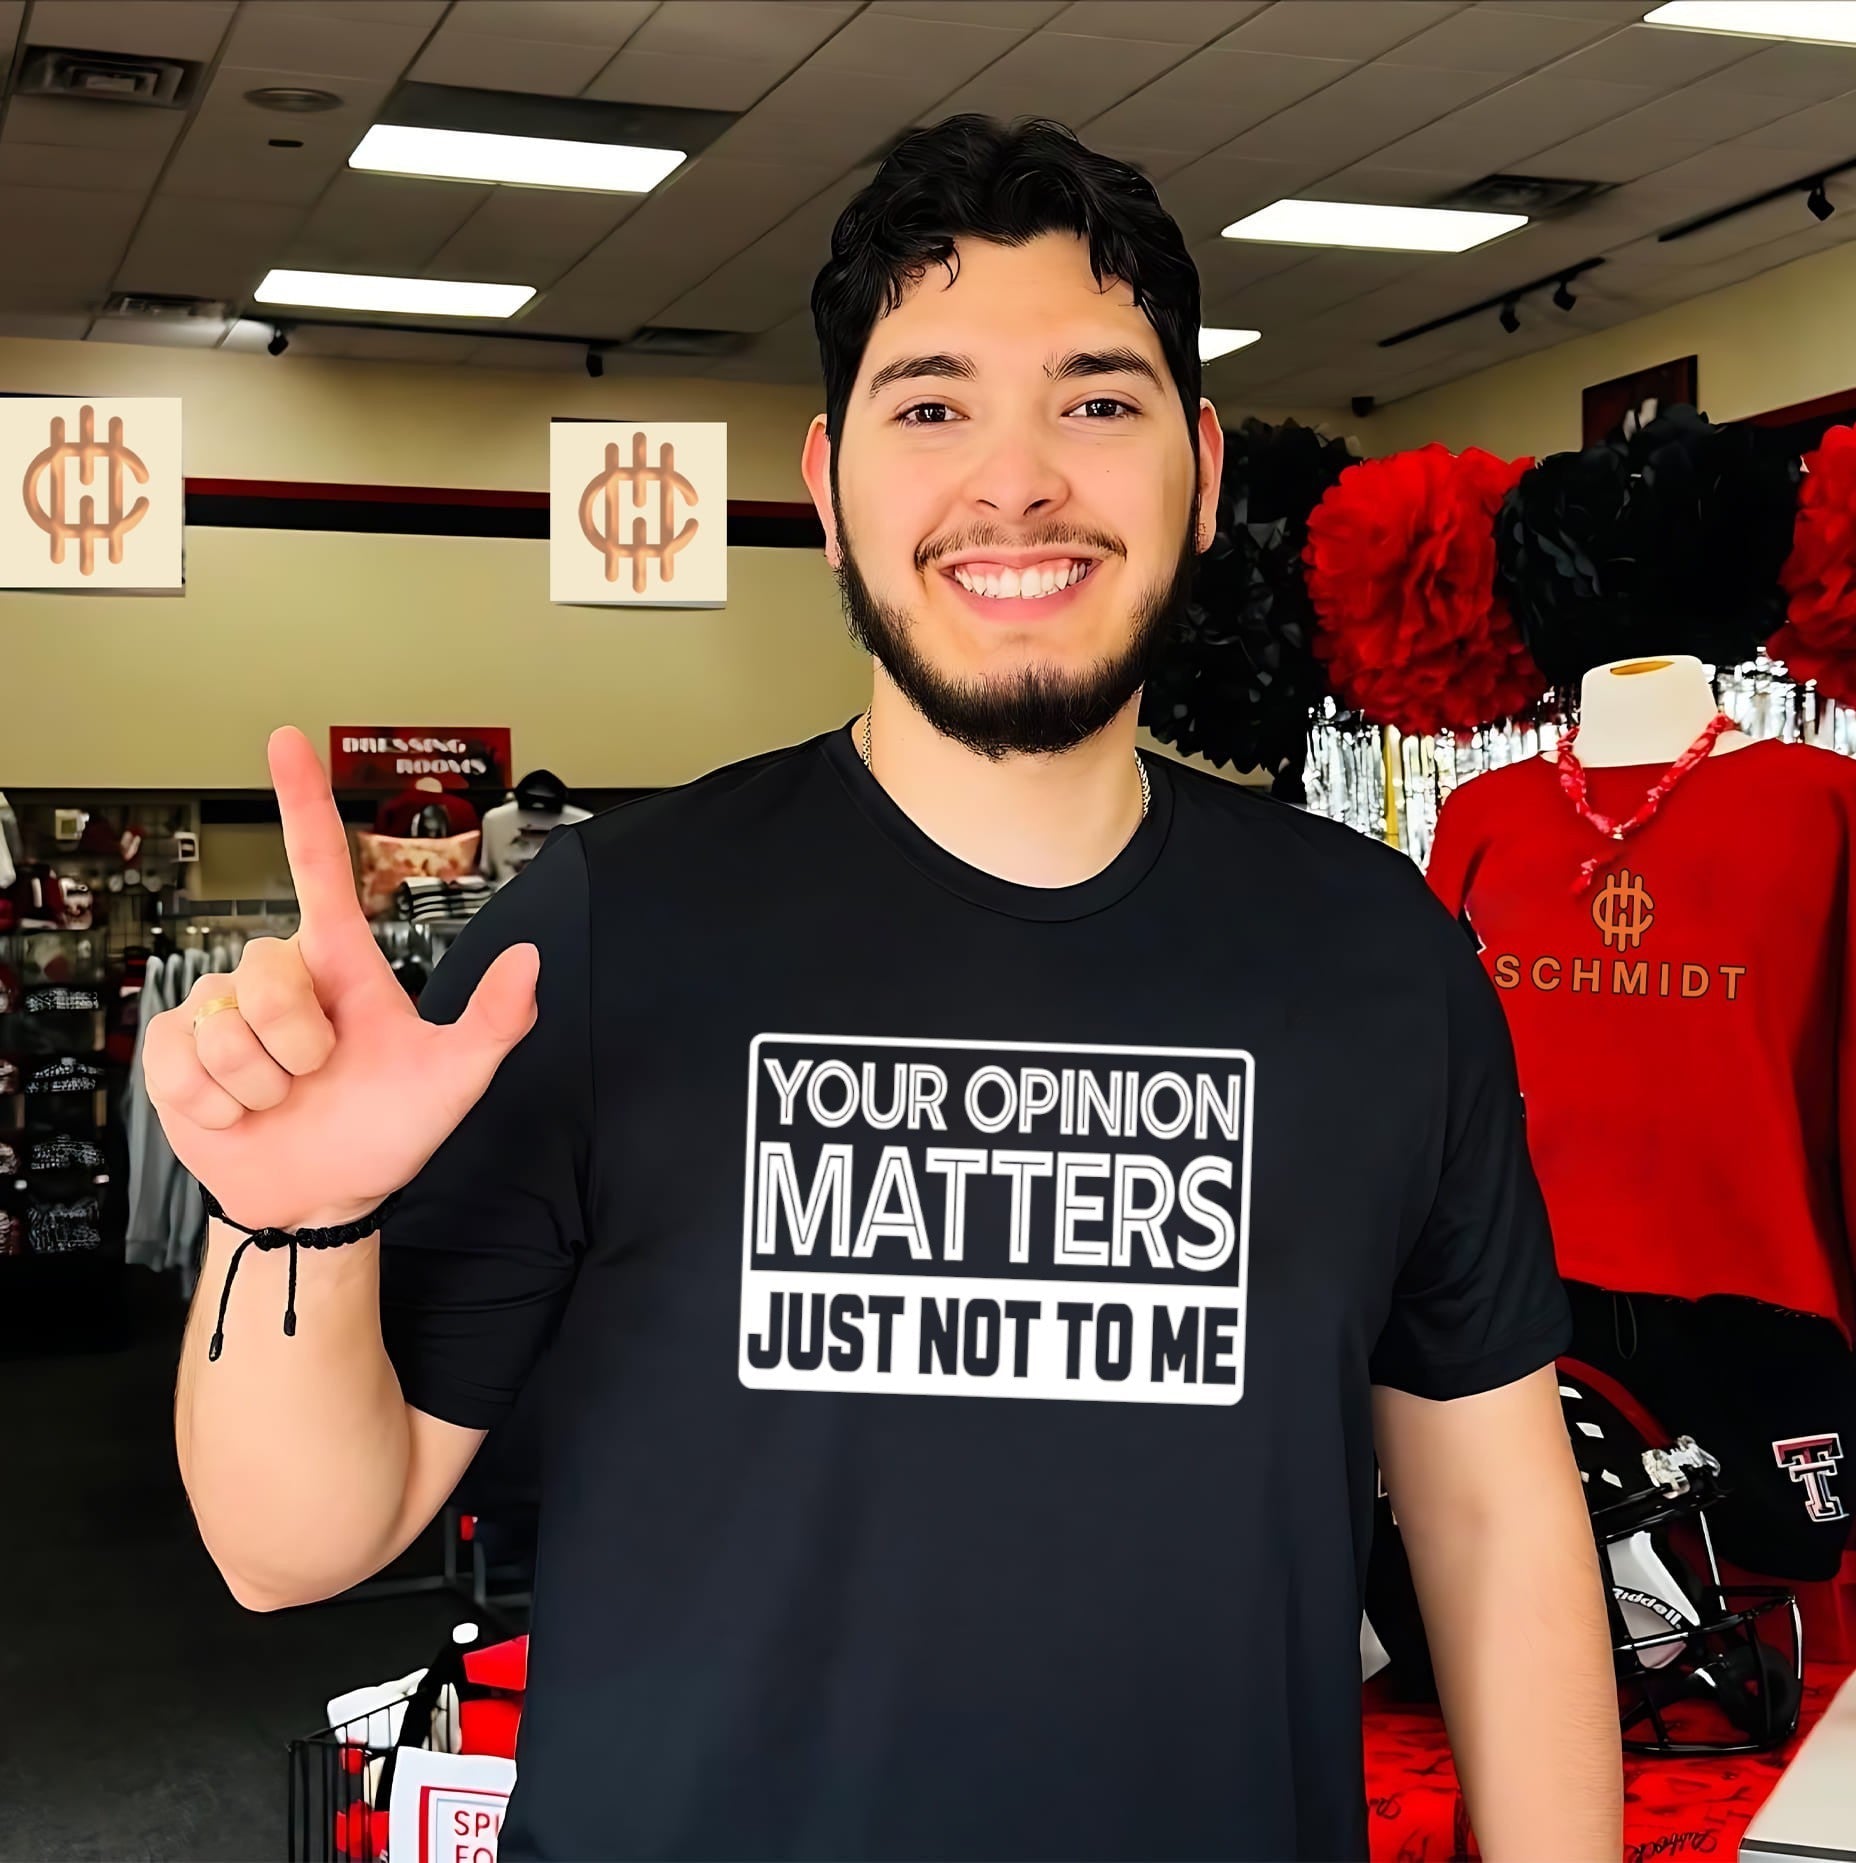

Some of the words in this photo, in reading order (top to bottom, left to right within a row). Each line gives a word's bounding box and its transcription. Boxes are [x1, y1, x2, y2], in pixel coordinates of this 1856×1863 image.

[342, 737, 466, 754] DRESSING
[396, 759, 487, 775] ROOMS
[1494, 953, 1747, 1000] SCHMIDT
[764, 1058, 948, 1131] YOUR
[964, 1064, 1241, 1141] OPINION
[756, 1141, 1236, 1272] MATTERS
[747, 1291, 905, 1373] JUST
[918, 1296, 1041, 1379] NOT
[1057, 1301, 1133, 1382] TO
[1150, 1305, 1239, 1385] ME
